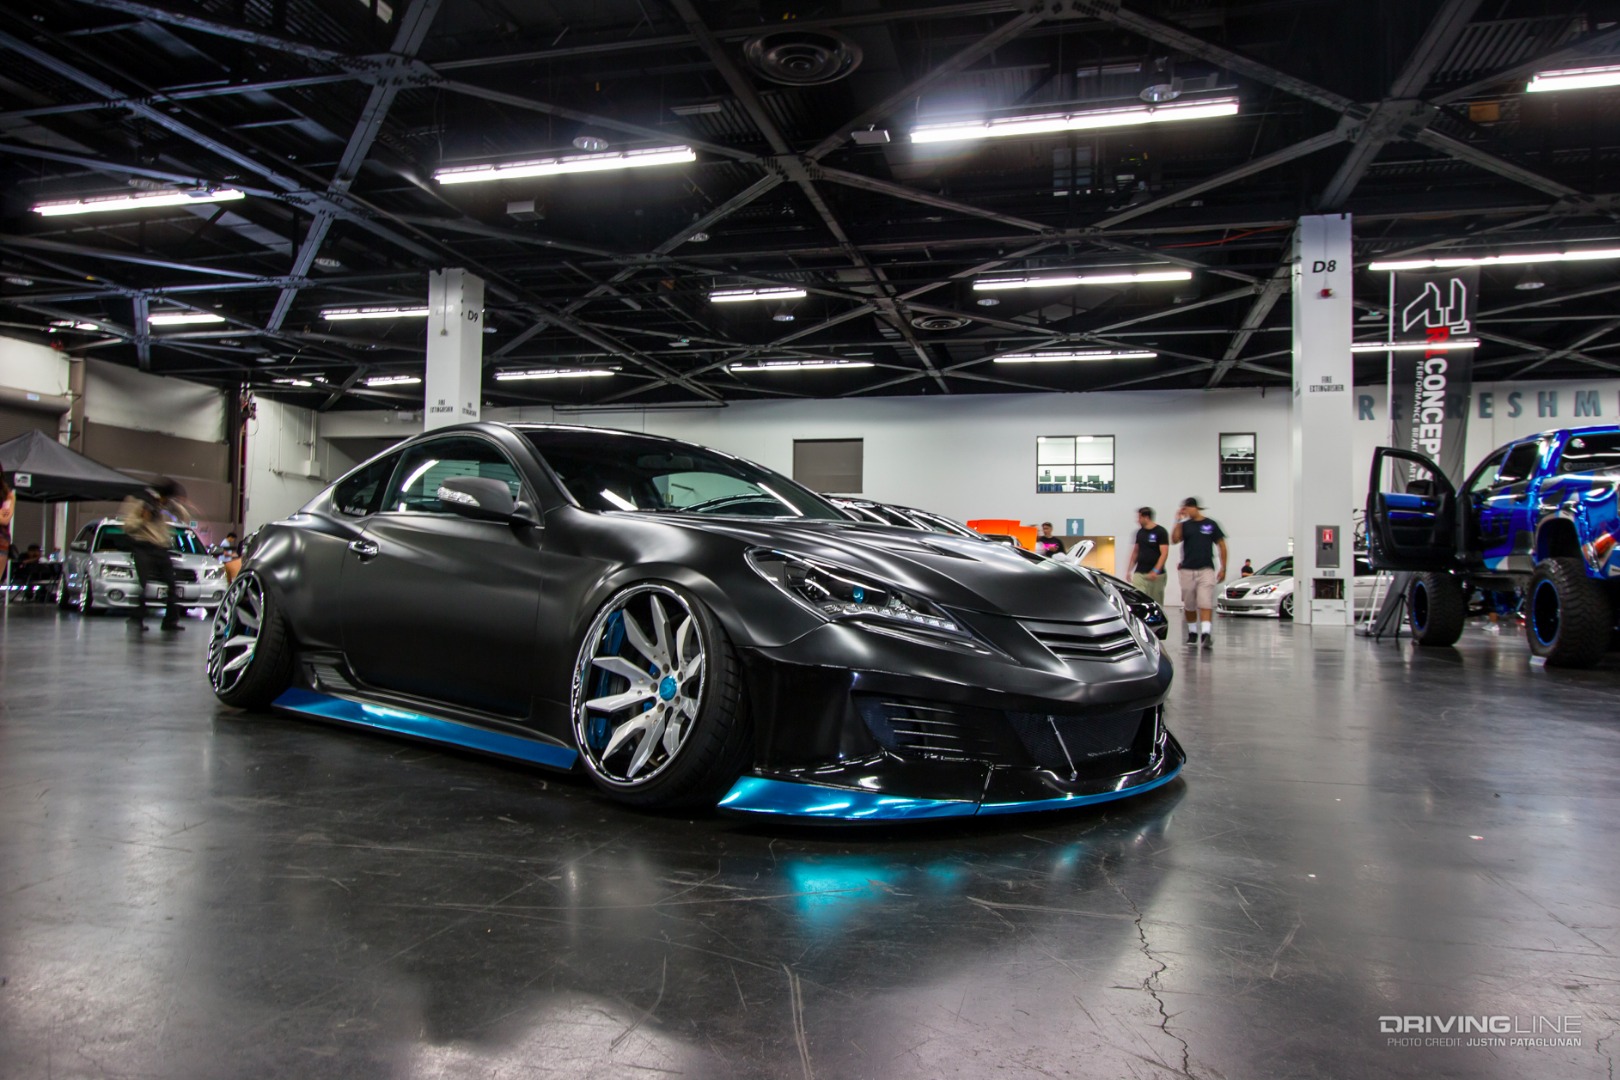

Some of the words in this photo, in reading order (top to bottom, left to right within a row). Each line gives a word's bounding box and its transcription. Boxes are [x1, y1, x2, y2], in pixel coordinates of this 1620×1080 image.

[1312, 260, 1337, 273] D8
[467, 309, 479, 323] D9
[1412, 361, 1424, 424] PERFORMANCE
